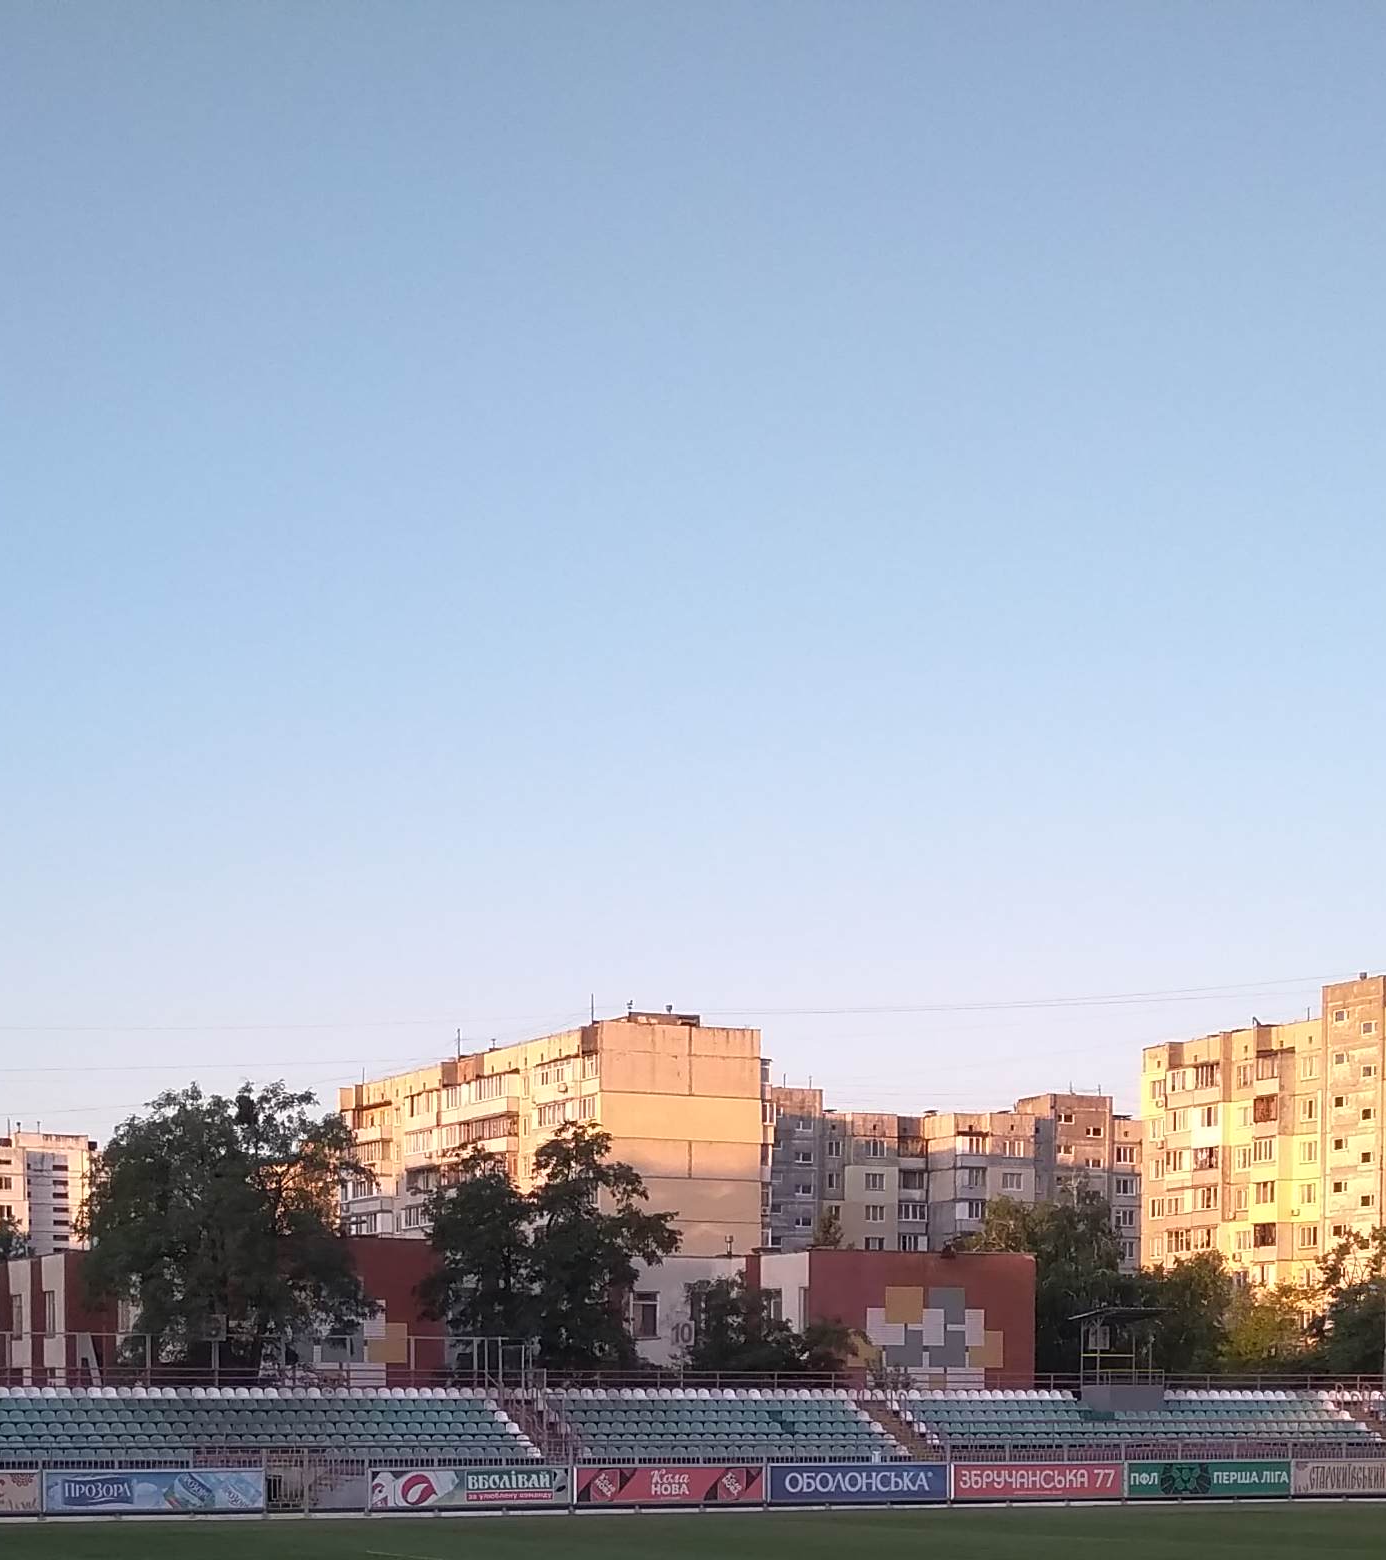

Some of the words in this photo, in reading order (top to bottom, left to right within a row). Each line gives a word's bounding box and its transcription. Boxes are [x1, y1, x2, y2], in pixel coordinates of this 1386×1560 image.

[672, 1323, 693, 1343] 10
[651, 1468, 690, 1484] Кола
[785, 1471, 930, 1493] ОБОЛОНСЬКА
[959, 1470, 1088, 1489] ЗБРУЧАНСЬКА
[1093, 1470, 1116, 1488] 77
[1130, 1473, 1158, 1485] ПФЛ
[1213, 1471, 1259, 1485] ПЕРША
[1261, 1471, 1289, 1483] ЛІГА
[64, 1482, 131, 1498] ПРОЗОРА
[651, 1484, 690, 1496] НОВА
